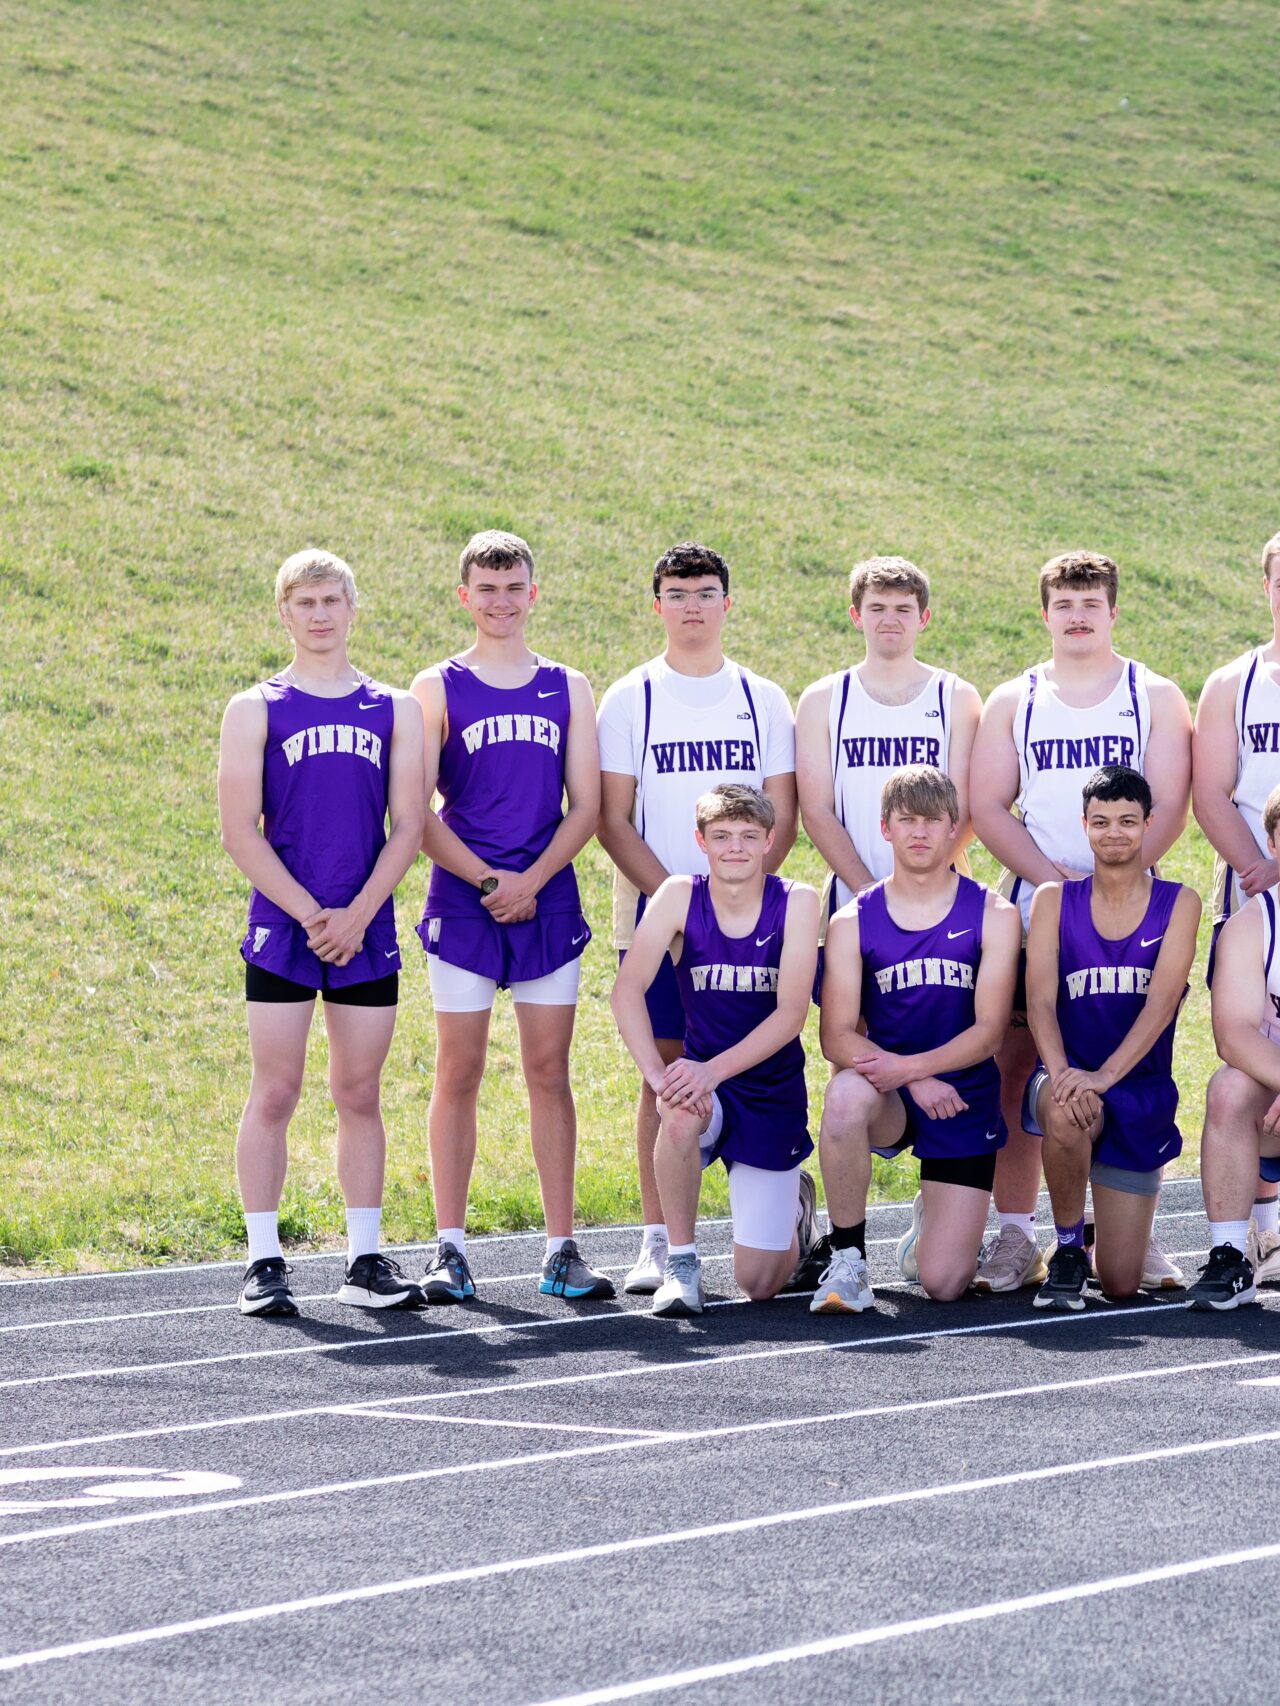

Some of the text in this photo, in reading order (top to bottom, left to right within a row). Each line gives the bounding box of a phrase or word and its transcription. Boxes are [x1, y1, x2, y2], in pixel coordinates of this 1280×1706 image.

[282, 724, 381, 769] WINNER
[462, 715, 560, 755] WINNER
[842, 737, 940, 768] WINNER
[1030, 735, 1135, 771] WINNER
[651, 740, 756, 774] WINNER
[875, 958, 974, 994] WINNER
[1066, 965, 1152, 1000] WINNE
